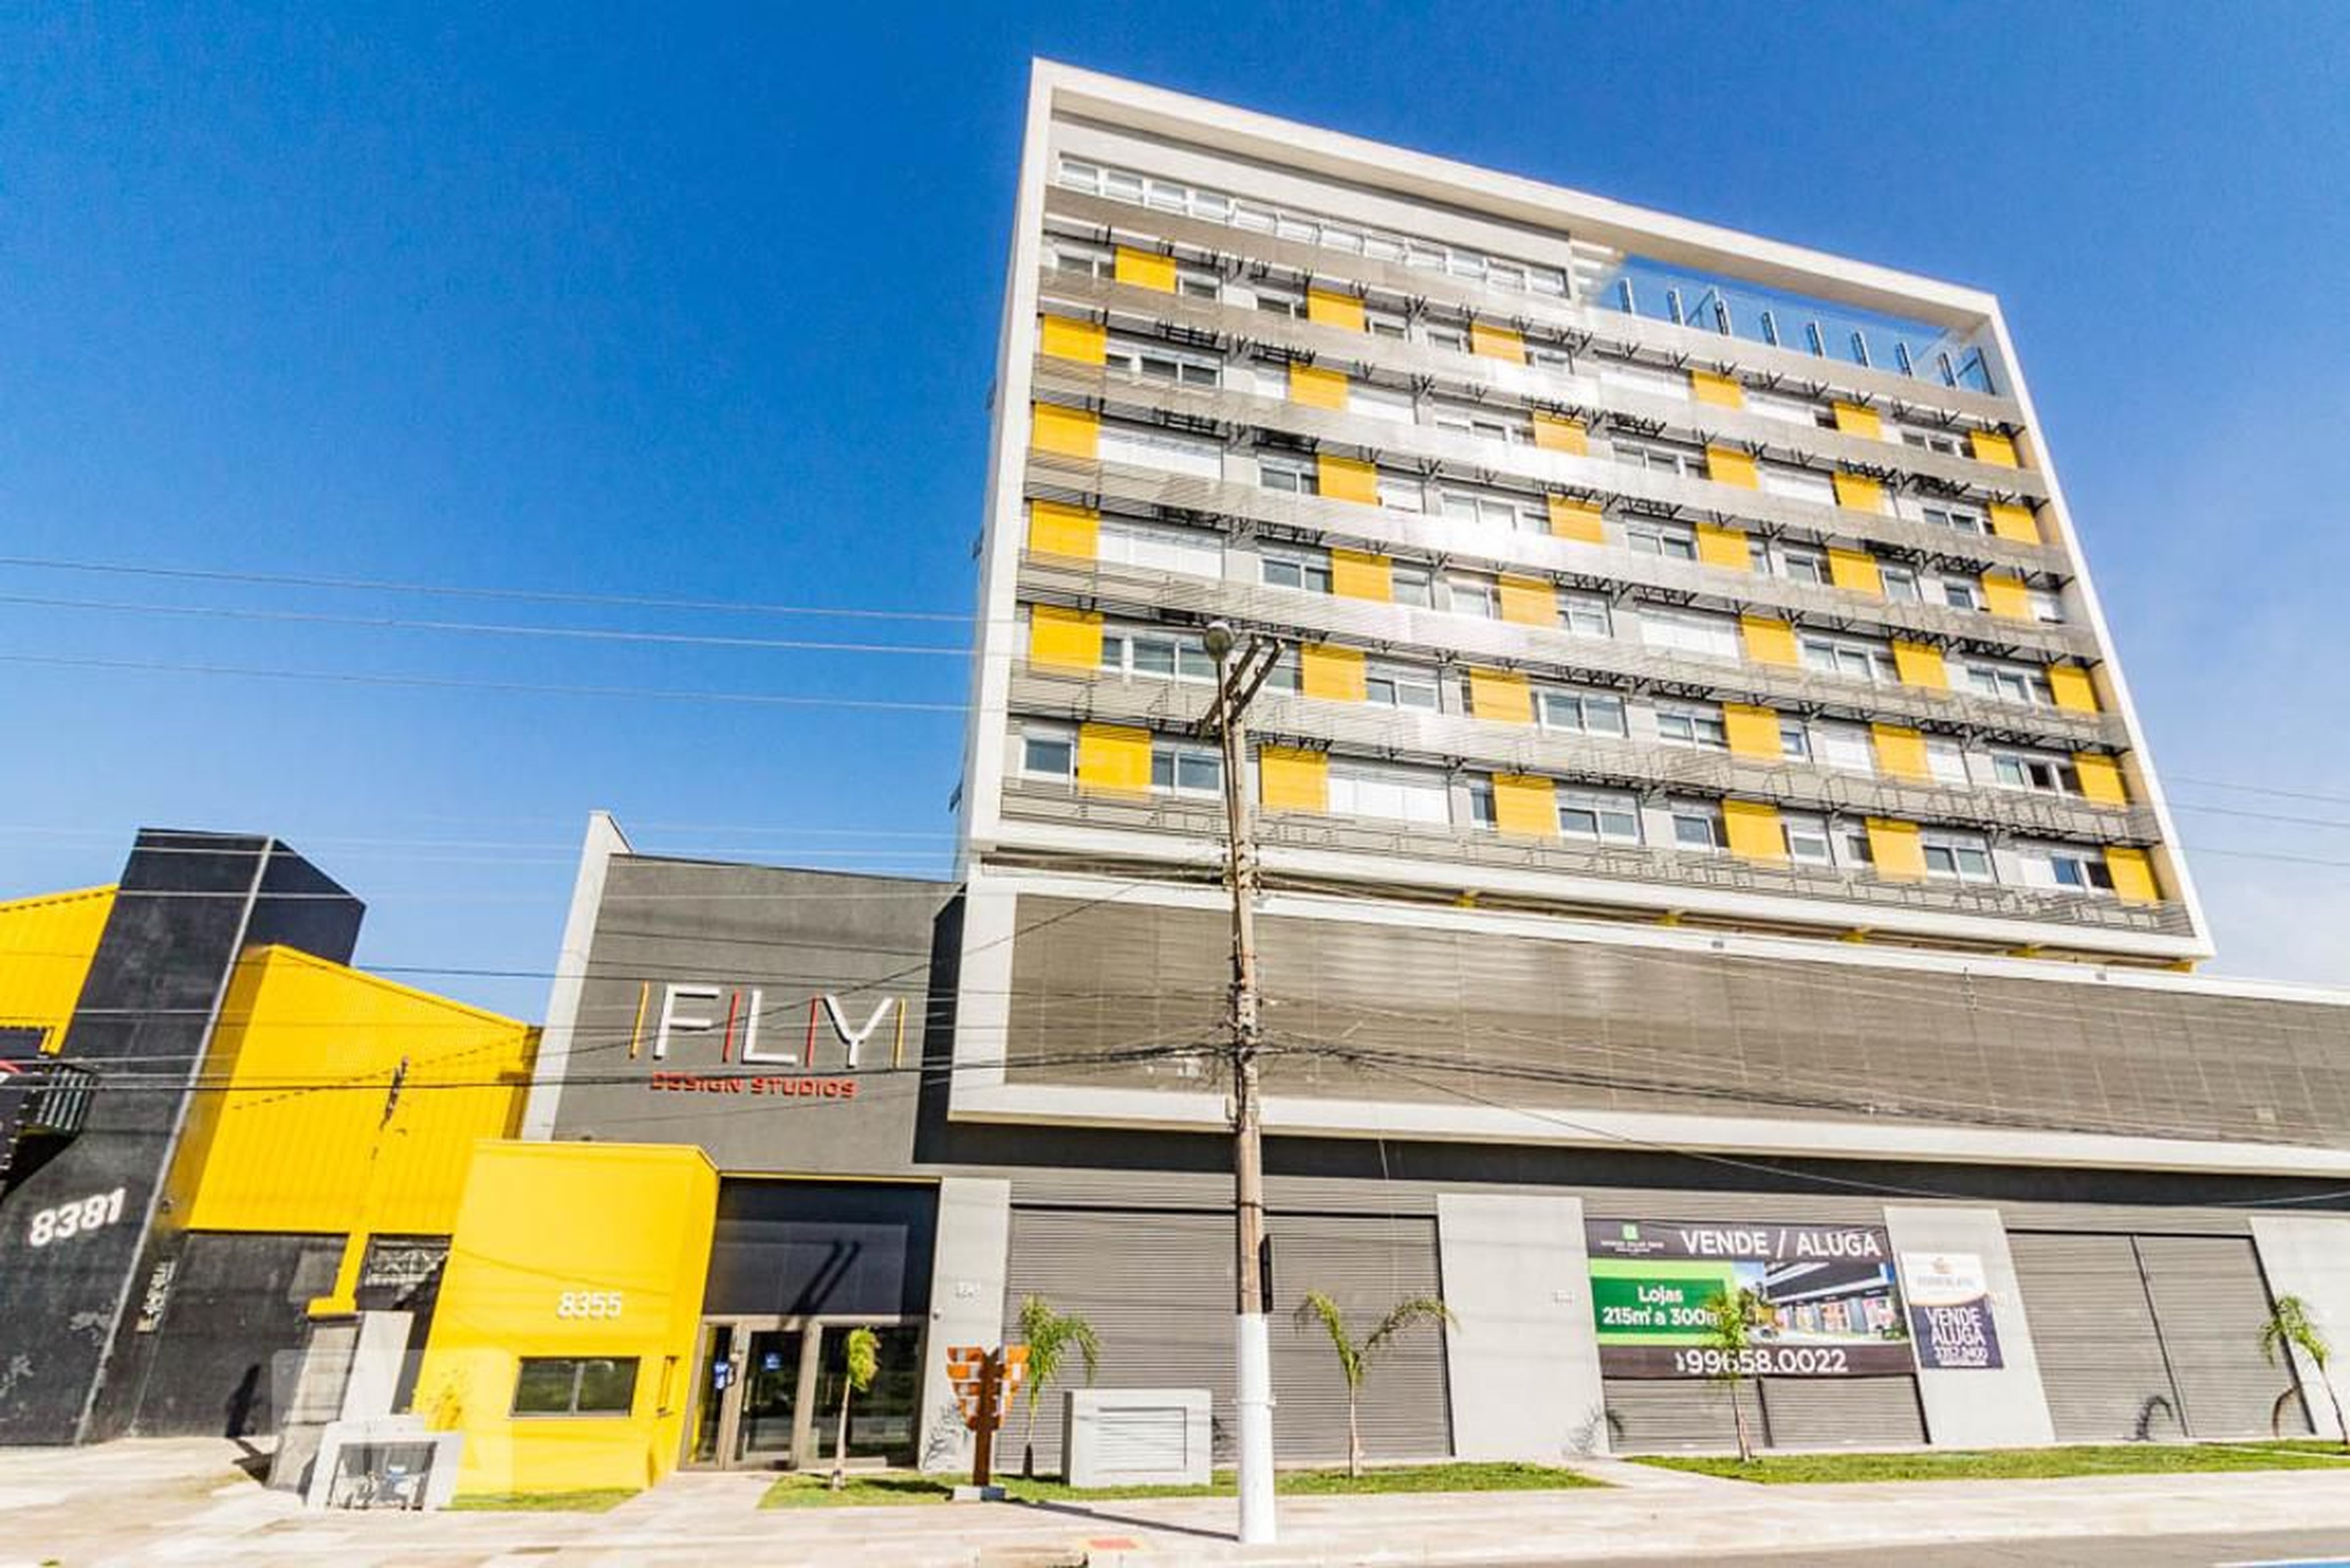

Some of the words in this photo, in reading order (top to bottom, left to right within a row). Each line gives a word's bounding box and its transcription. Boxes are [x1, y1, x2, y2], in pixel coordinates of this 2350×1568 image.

[650, 1071, 744, 1094] DESIGN
[750, 1077, 858, 1099] STUDIOS
[30, 1187, 126, 1247] 8381
[1681, 1230, 1770, 1255] VENDE
[1796, 1233, 1882, 1256] ALUGA
[556, 1290, 623, 1320] 8355
[1638, 1286, 1683, 1305] Lojas
[1654, 1311, 1666, 1325] a
[1925, 1307, 1983, 1327] VENDE
[1931, 1324, 1988, 1345] ALUGA
[1686, 1348, 1849, 1374] 99658.0022
